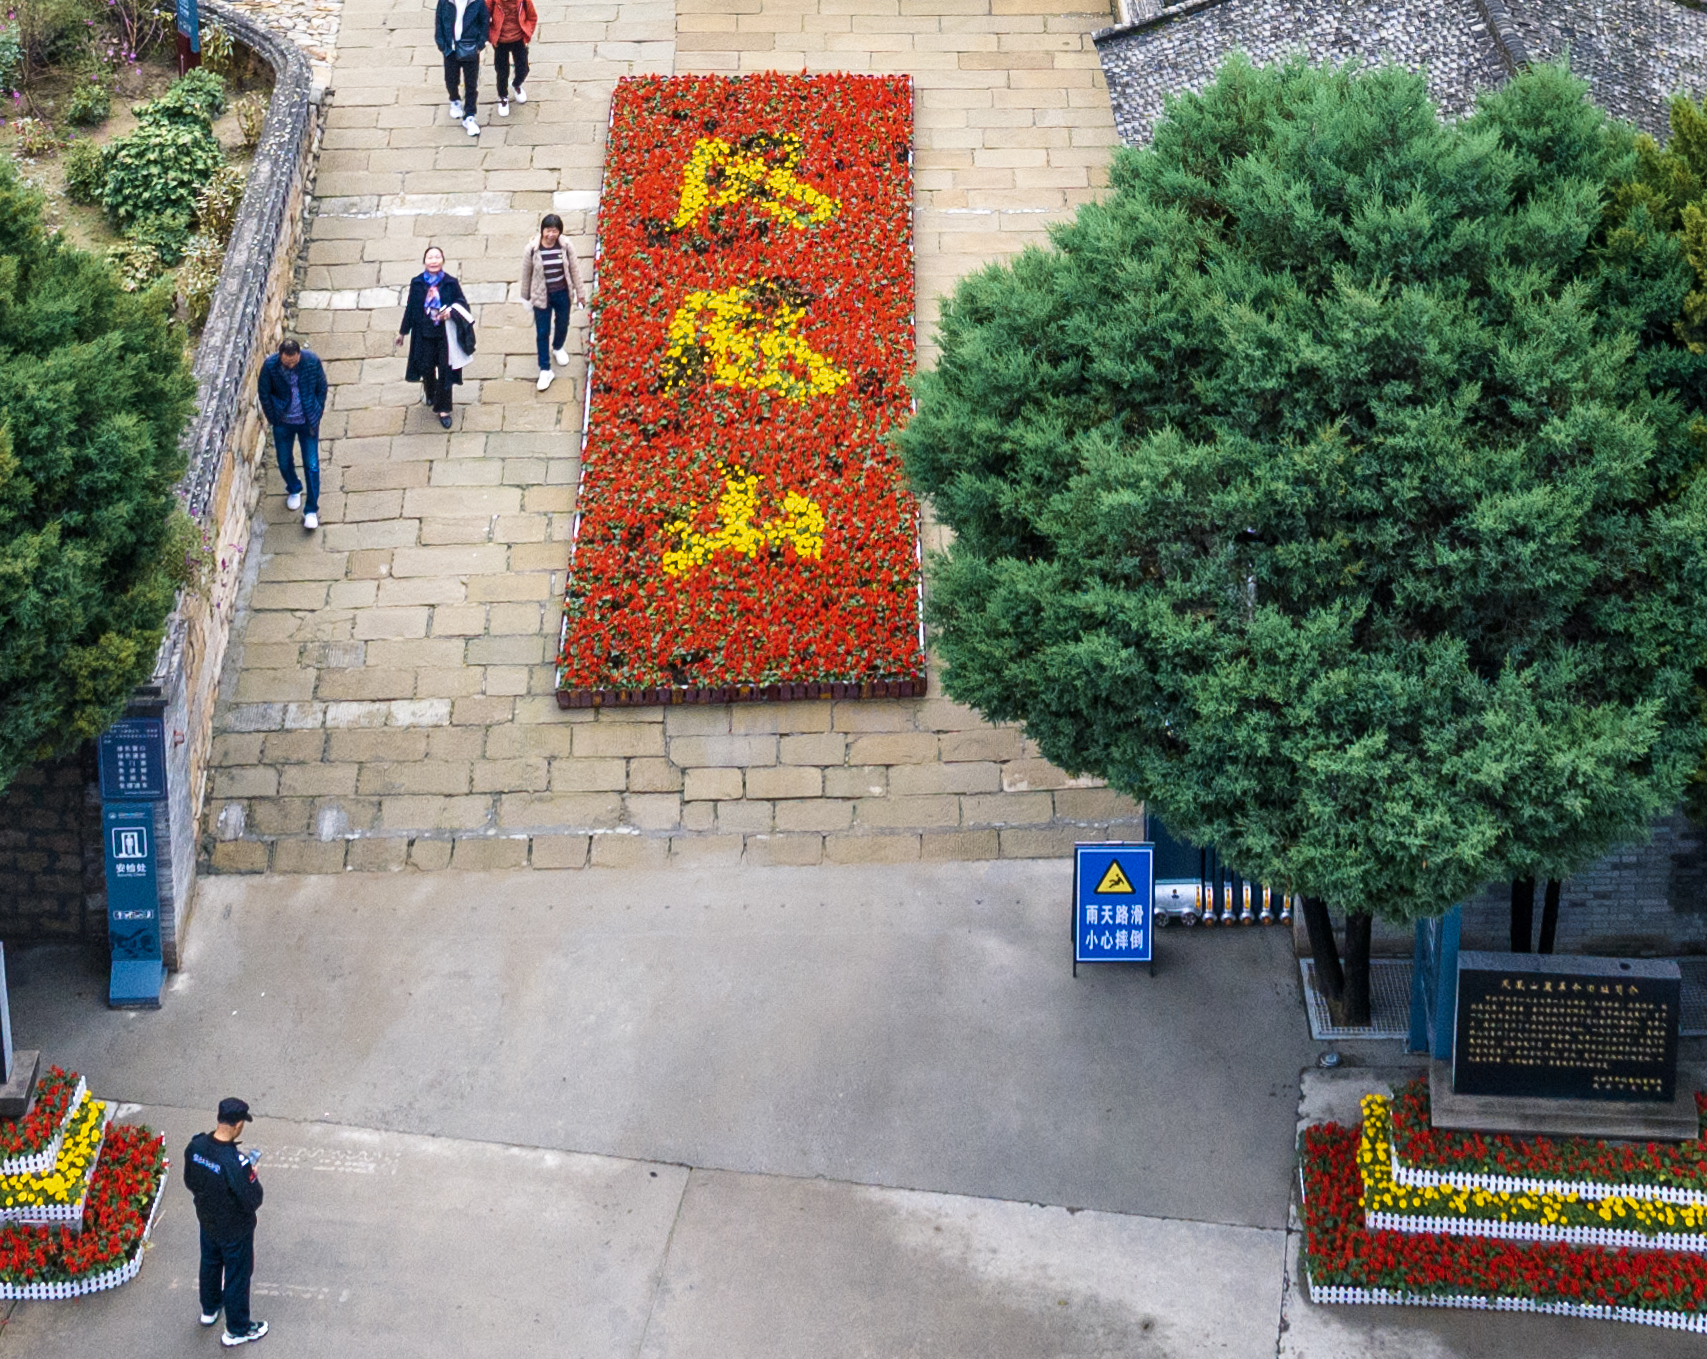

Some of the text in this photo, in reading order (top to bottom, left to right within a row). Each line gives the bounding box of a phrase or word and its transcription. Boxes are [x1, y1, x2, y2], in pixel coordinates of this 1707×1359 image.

[115, 863, 147, 873] 安检处
[1085, 904, 1144, 926] 雨天路滑
[1085, 929, 1144, 951] 小心摔倒
